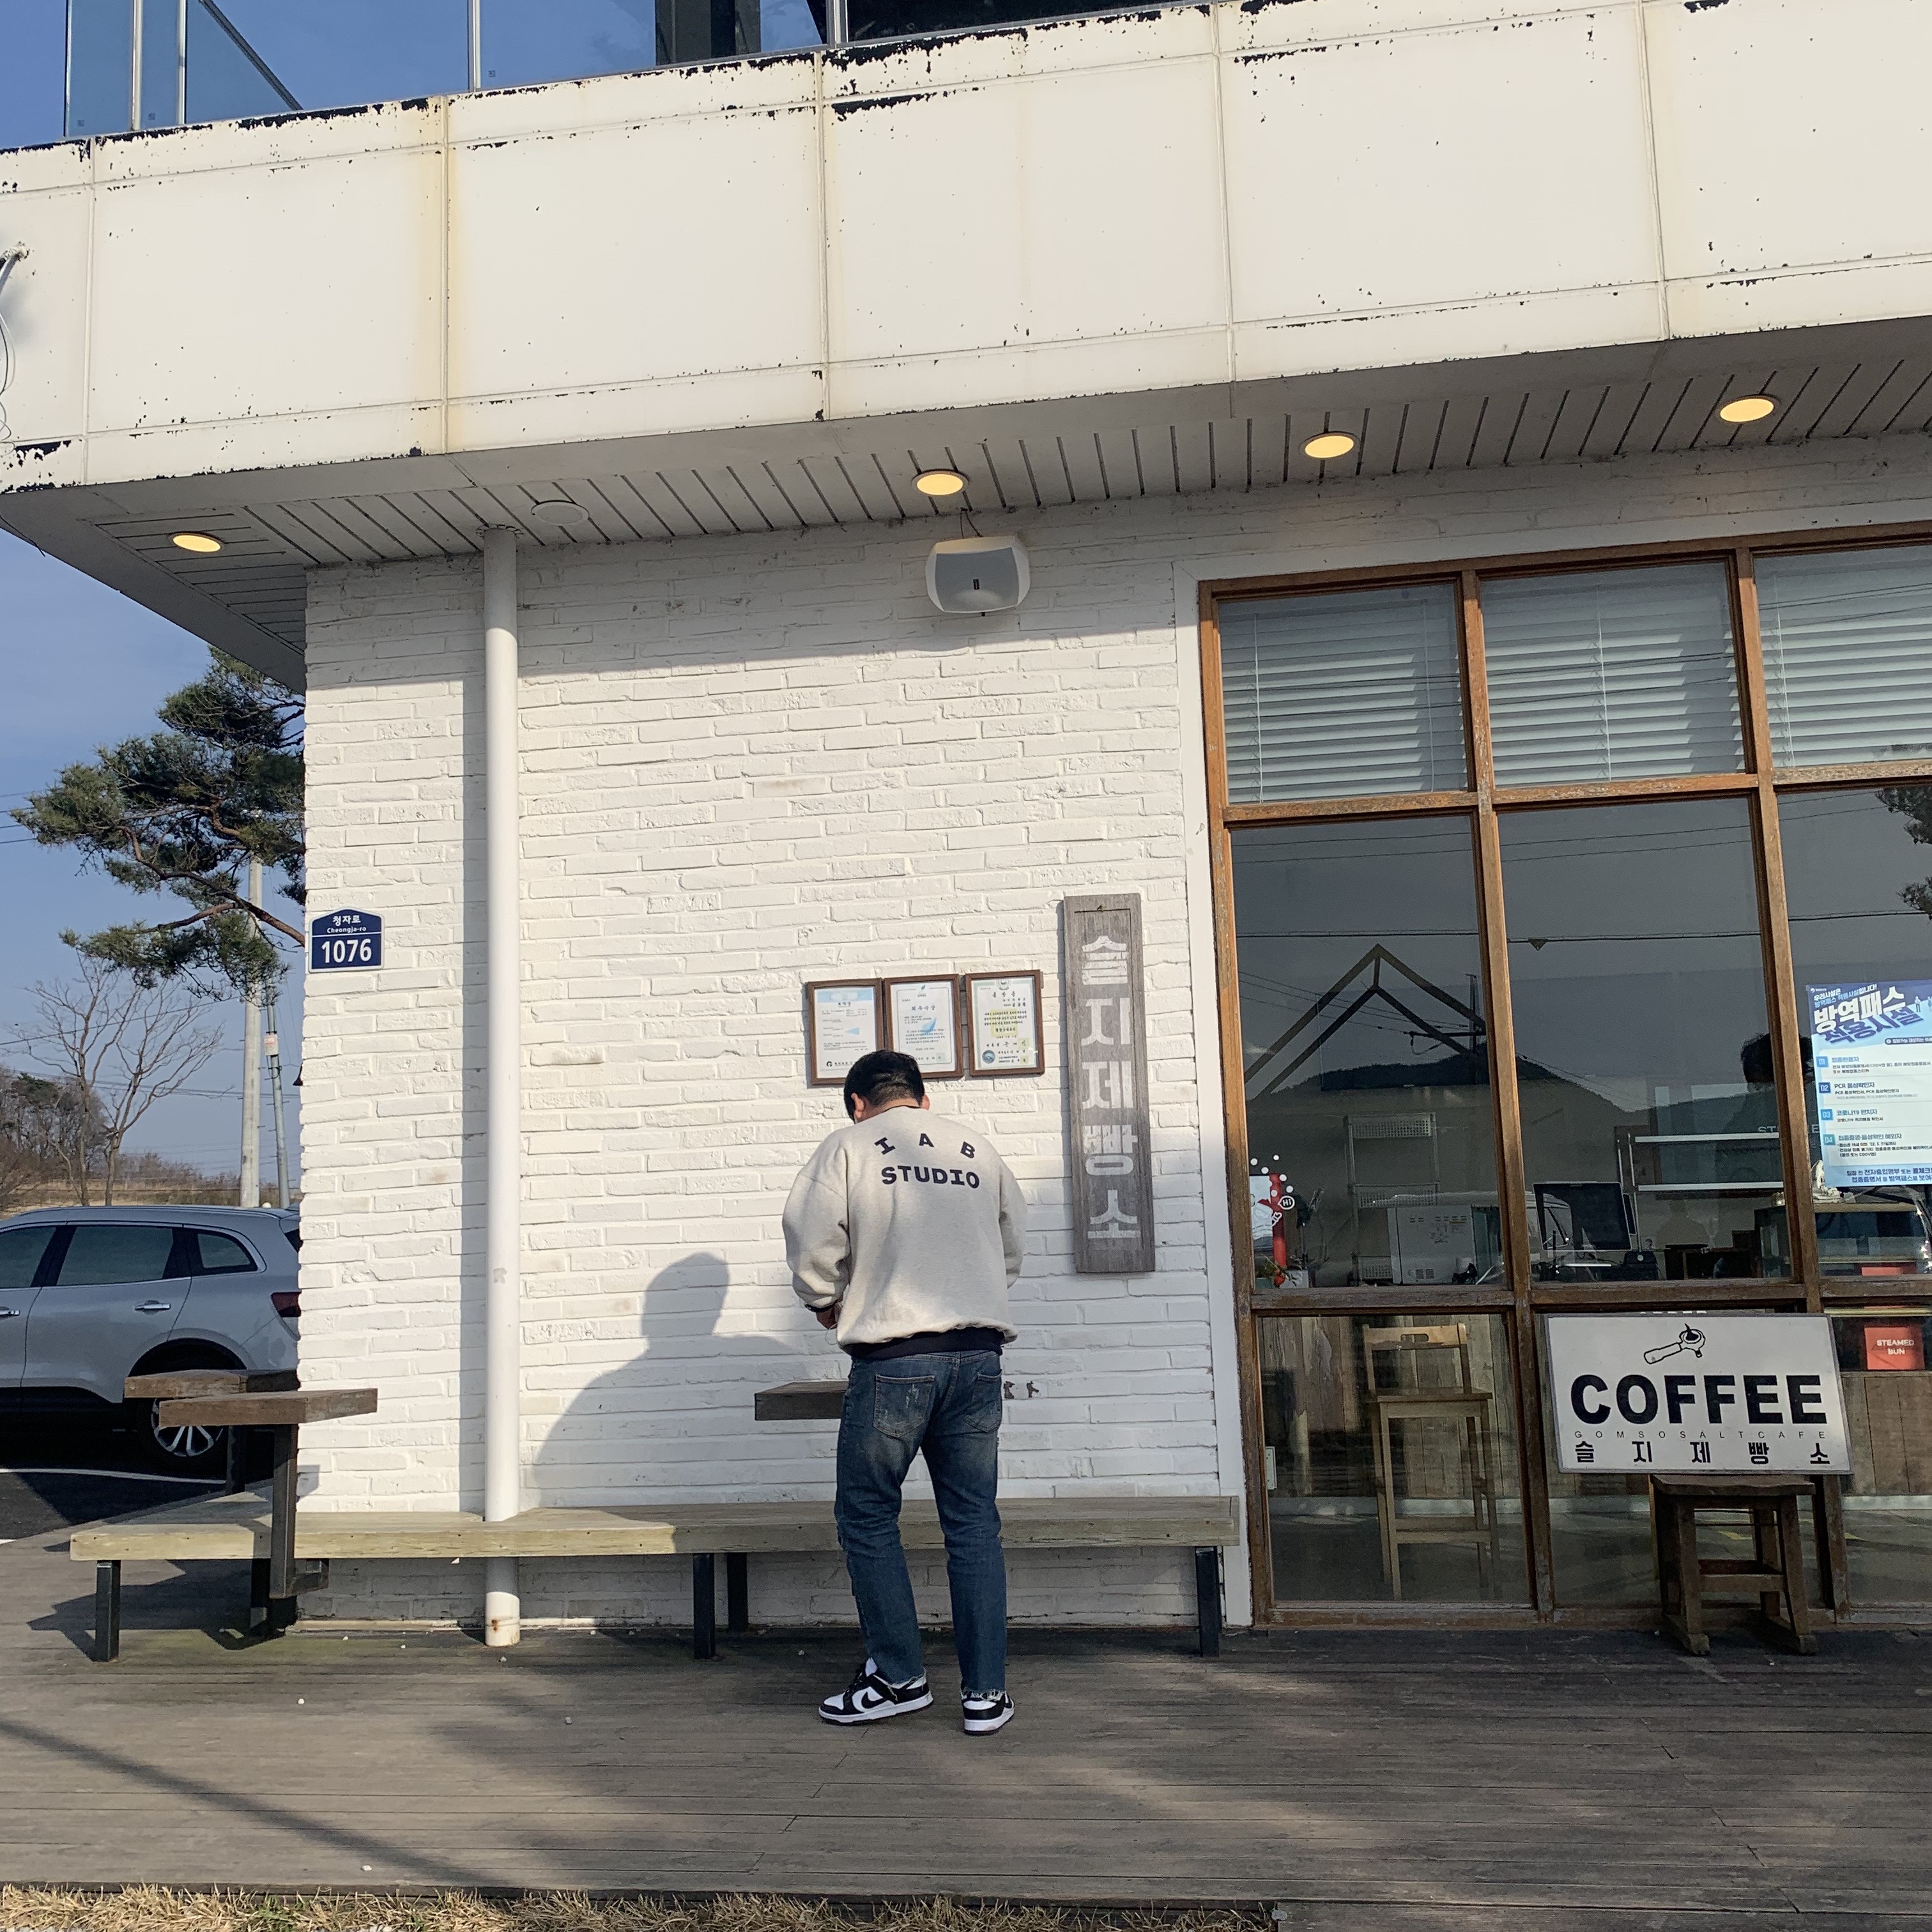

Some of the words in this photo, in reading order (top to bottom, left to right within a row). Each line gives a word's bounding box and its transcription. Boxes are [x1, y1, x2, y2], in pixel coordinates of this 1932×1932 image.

[333, 915, 361, 926] 청자로
[321, 939, 372, 963] 1076
[1814, 988, 1841, 1001] 우리시설은
[1814, 986, 1906, 1033] 방역패스
[1825, 1006, 1924, 1043] 적용시설
[881, 1165, 980, 1189] STUDIO
[1571, 1374, 1828, 1424] COFFEE
